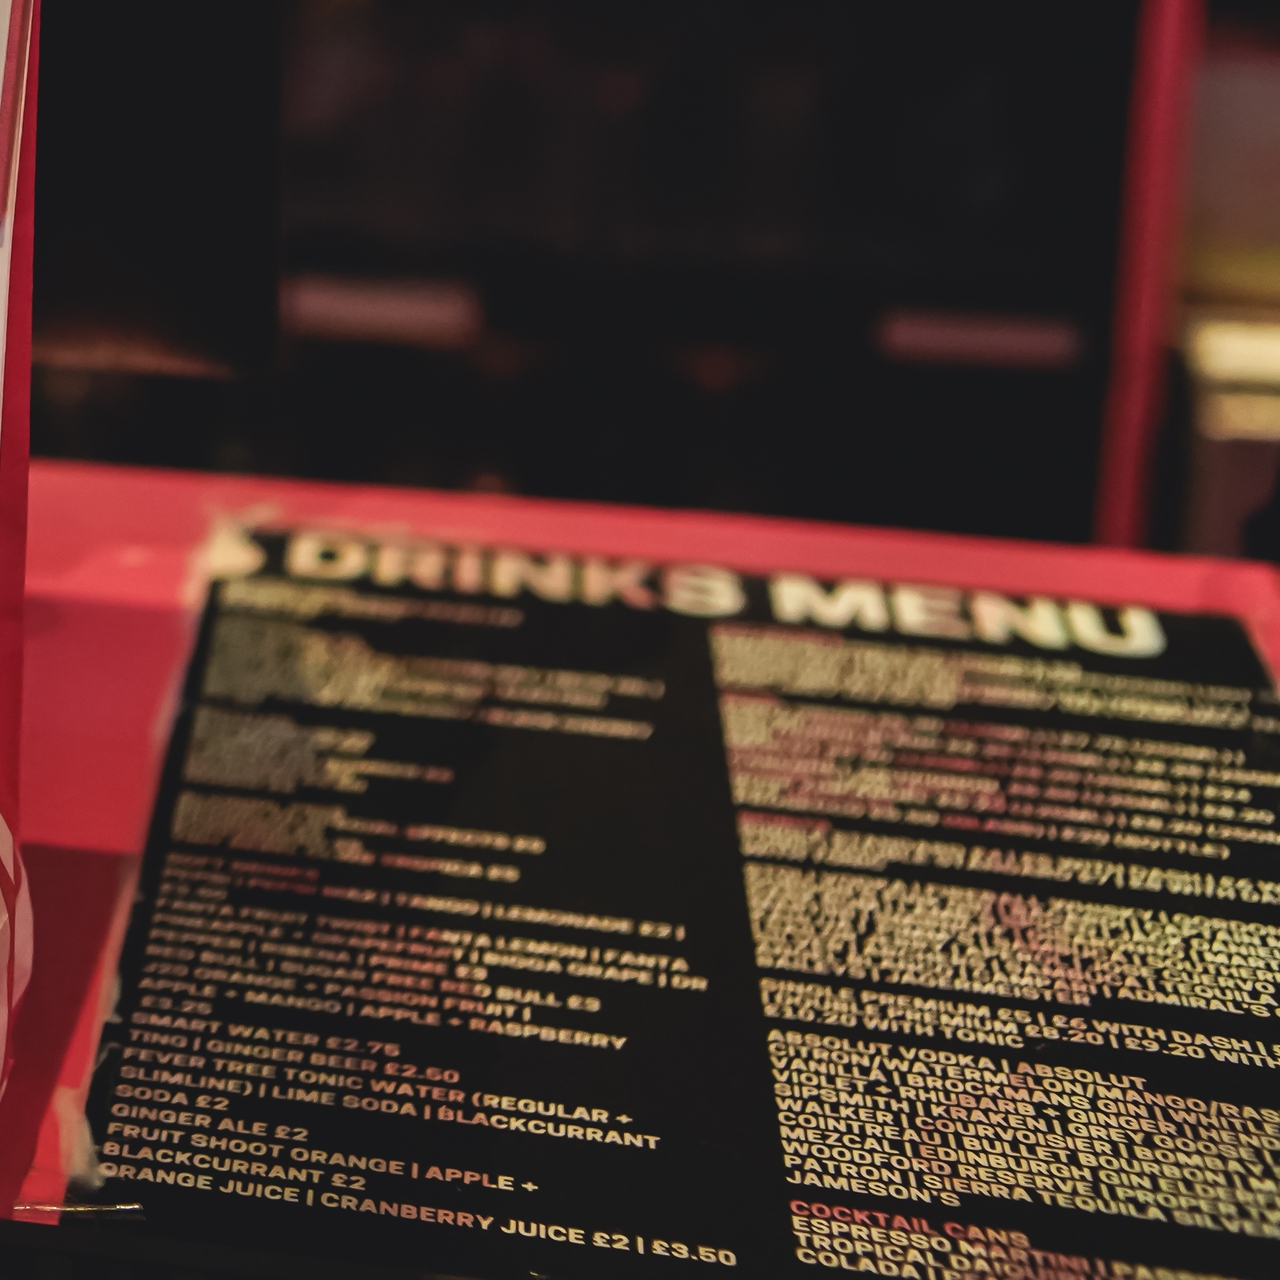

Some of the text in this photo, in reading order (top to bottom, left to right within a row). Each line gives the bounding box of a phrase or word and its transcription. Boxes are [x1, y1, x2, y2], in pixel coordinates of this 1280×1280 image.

[283, 531, 745, 617] DRINKS
[768, 571, 1168, 659] MENU
[442, 996, 518, 1018] FRUIT
[495, 985, 562, 1008] BULL
[1117, 988, 1271, 1017] ADMIRAL'S
[1159, 981, 1278, 1005] TEQUILA
[1162, 970, 1275, 993] CUERVO
[131, 1011, 222, 1034] SMART
[228, 1023, 319, 1047] WATER
[244, 989, 341, 1014] MANGO
[358, 1003, 441, 1026] APPLE
[468, 1018, 628, 1049] RASPBERRY
[860, 989, 991, 1018] PREMIUM
[1091, 1019, 1166, 1041] WITH
[1171, 1029, 1251, 1053] DASH
[862, 1015, 935, 1037] WITH
[939, 1026, 1025, 1049] TONIC
[886, 1006, 1280, 1069] PREMIUM £8.20 £9.20 WITH
[129, 1027, 187, 1048] TING
[206, 1038, 304, 1063] GINGER
[310, 1051, 377, 1073] BEER
[766, 1028, 1146, 1090] ABSOLUT VODKA ABSOLUT
[115, 1083, 230, 1112] SODA £2
[120, 1064, 660, 1149] SLIMLINE) LIME SODA BLACKCURRANT
[122, 1045, 609, 1124] FEVER TREE TONIC WATER (REGULAR
[768, 1055, 887, 1082] VANILLA
[907, 1075, 1090, 1107] BROCKMANS
[1096, 1099, 1148, 1118] GIN
[770, 1068, 868, 1093] VIOLET
[899, 1086, 1035, 1115] RHUBARB
[1066, 1108, 1177, 1135] GINGER
[110, 1102, 309, 1142] GINGER ALE £2
[773, 1082, 1256, 1161] SIPSMITH KRAKEN GREY GOOSE
[774, 1096, 1264, 1175] WALKER COURVOISIER BOMBAY
[777, 1110, 1227, 1185] COINTREAU BULLET BOURBON
[102, 1141, 366, 1190] BLACKCURRANT £2
[106, 1121, 514, 1190] FRUIT SHOOT ORANGE APPLE
[780, 1125, 898, 1154] MEZCAL
[918, 1145, 1093, 1179] EDINBURGH
[1098, 1169, 1153, 1189] GIN
[781, 1139, 1238, 1216] WOODFORD RESERVE PROPER
[99, 1162, 737, 1266] ORANGE JUICE CRANBERRY JUICE £2 £3.50
[784, 1154, 902, 1183] PATRON
[923, 1174, 1033, 1202] SIERRA
[1037, 1191, 1168, 1222] TEQUILA
[785, 1170, 961, 1206] JAMESON'S
[789, 1200, 1031, 1248] COCKTAIL CANS
[790, 1216, 953, 1252] ESPRESSO
[958, 1241, 1090, 1271] MARTINI
[791, 1231, 945, 1266] TROPICAL
[795, 1248, 923, 1279] COLADA
